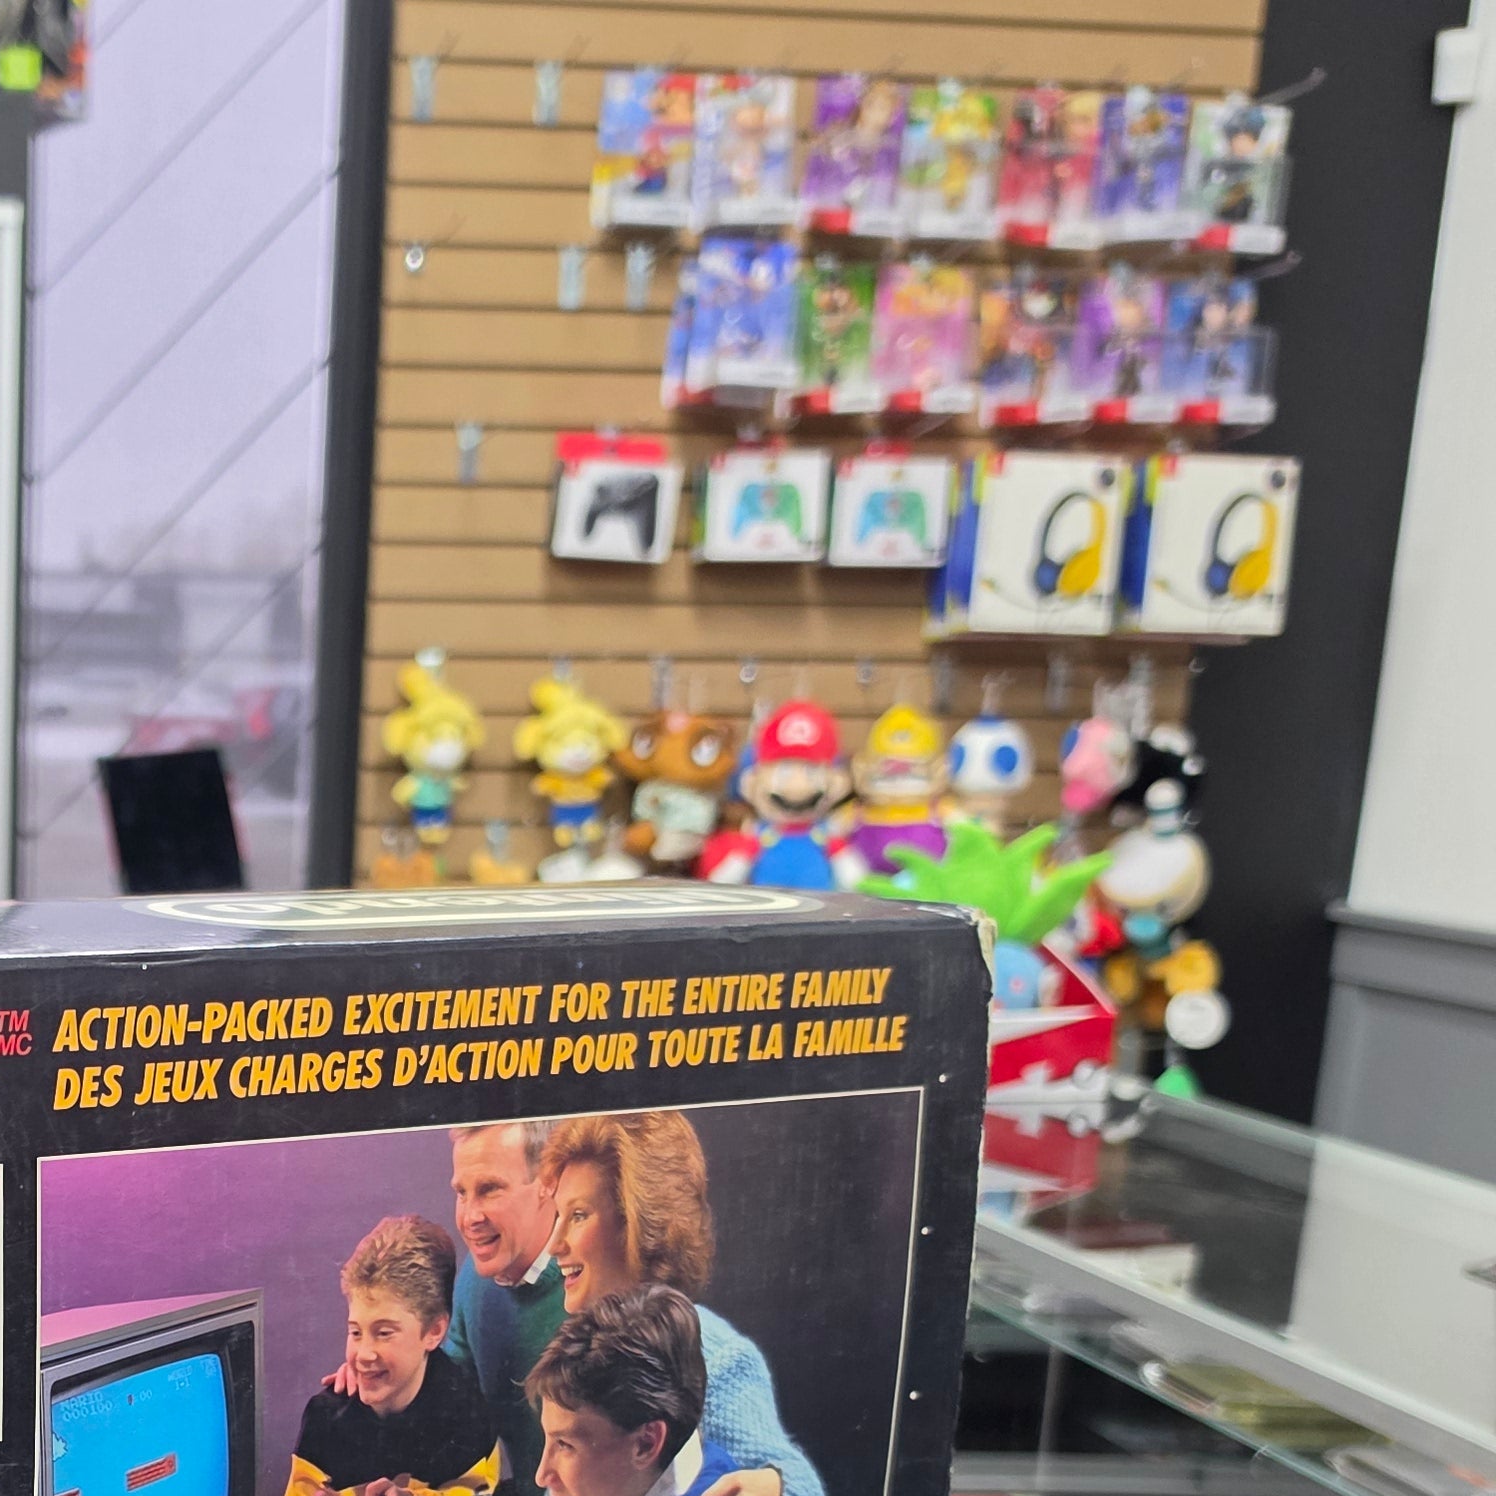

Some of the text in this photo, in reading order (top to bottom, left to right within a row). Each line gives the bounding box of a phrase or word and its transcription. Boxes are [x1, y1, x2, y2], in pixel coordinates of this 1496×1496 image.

[52, 967, 892, 1052] ACTION-PACKED EXCITEMENT FOR THE ENTIRE FAMILY
[53, 1015, 908, 1110] DES JEUX CHARGES D'ACTION POUR TOUTE LA FAMILLE
